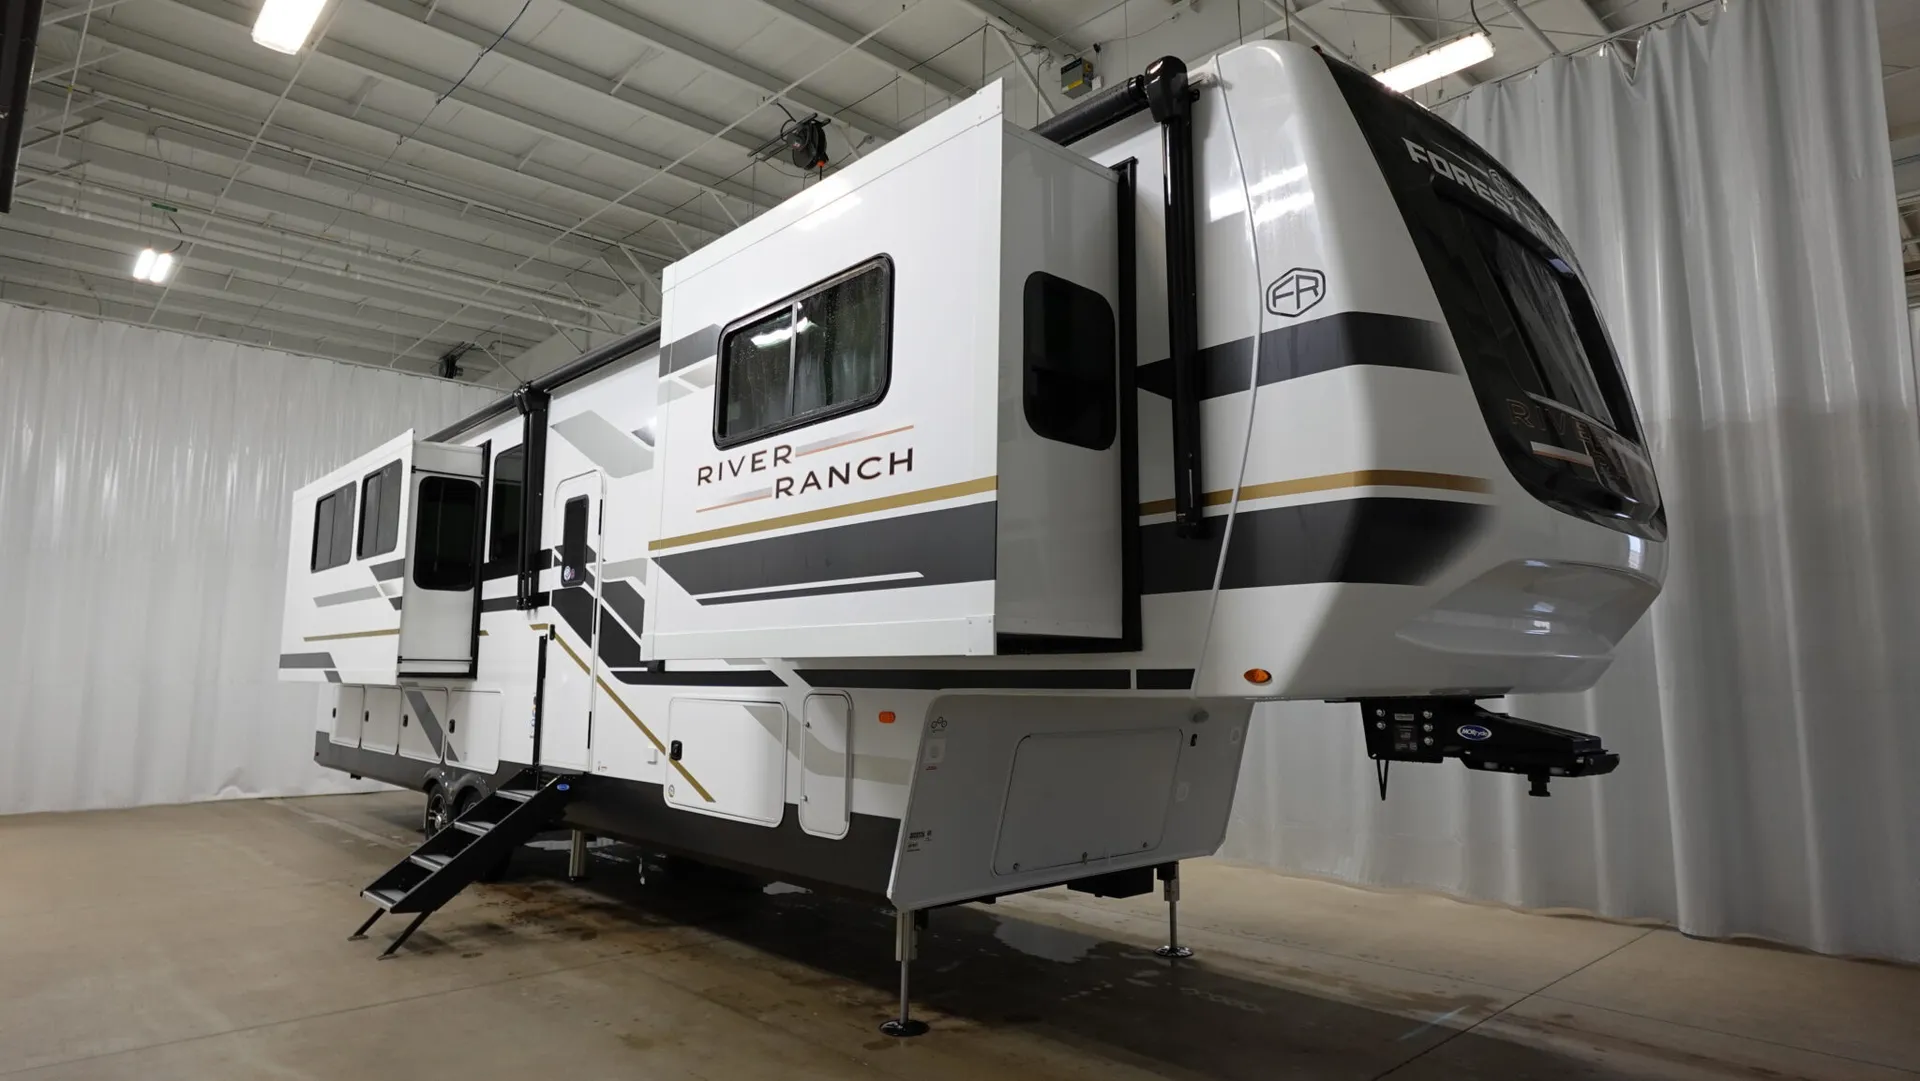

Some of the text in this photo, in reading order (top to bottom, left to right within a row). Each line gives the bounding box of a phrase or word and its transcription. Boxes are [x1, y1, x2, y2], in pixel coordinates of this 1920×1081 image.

[1401, 137, 1522, 223] FOREST
[1271, 274, 1320, 310] FR
[697, 444, 792, 486] RIVER
[775, 448, 913, 499] RANCH
